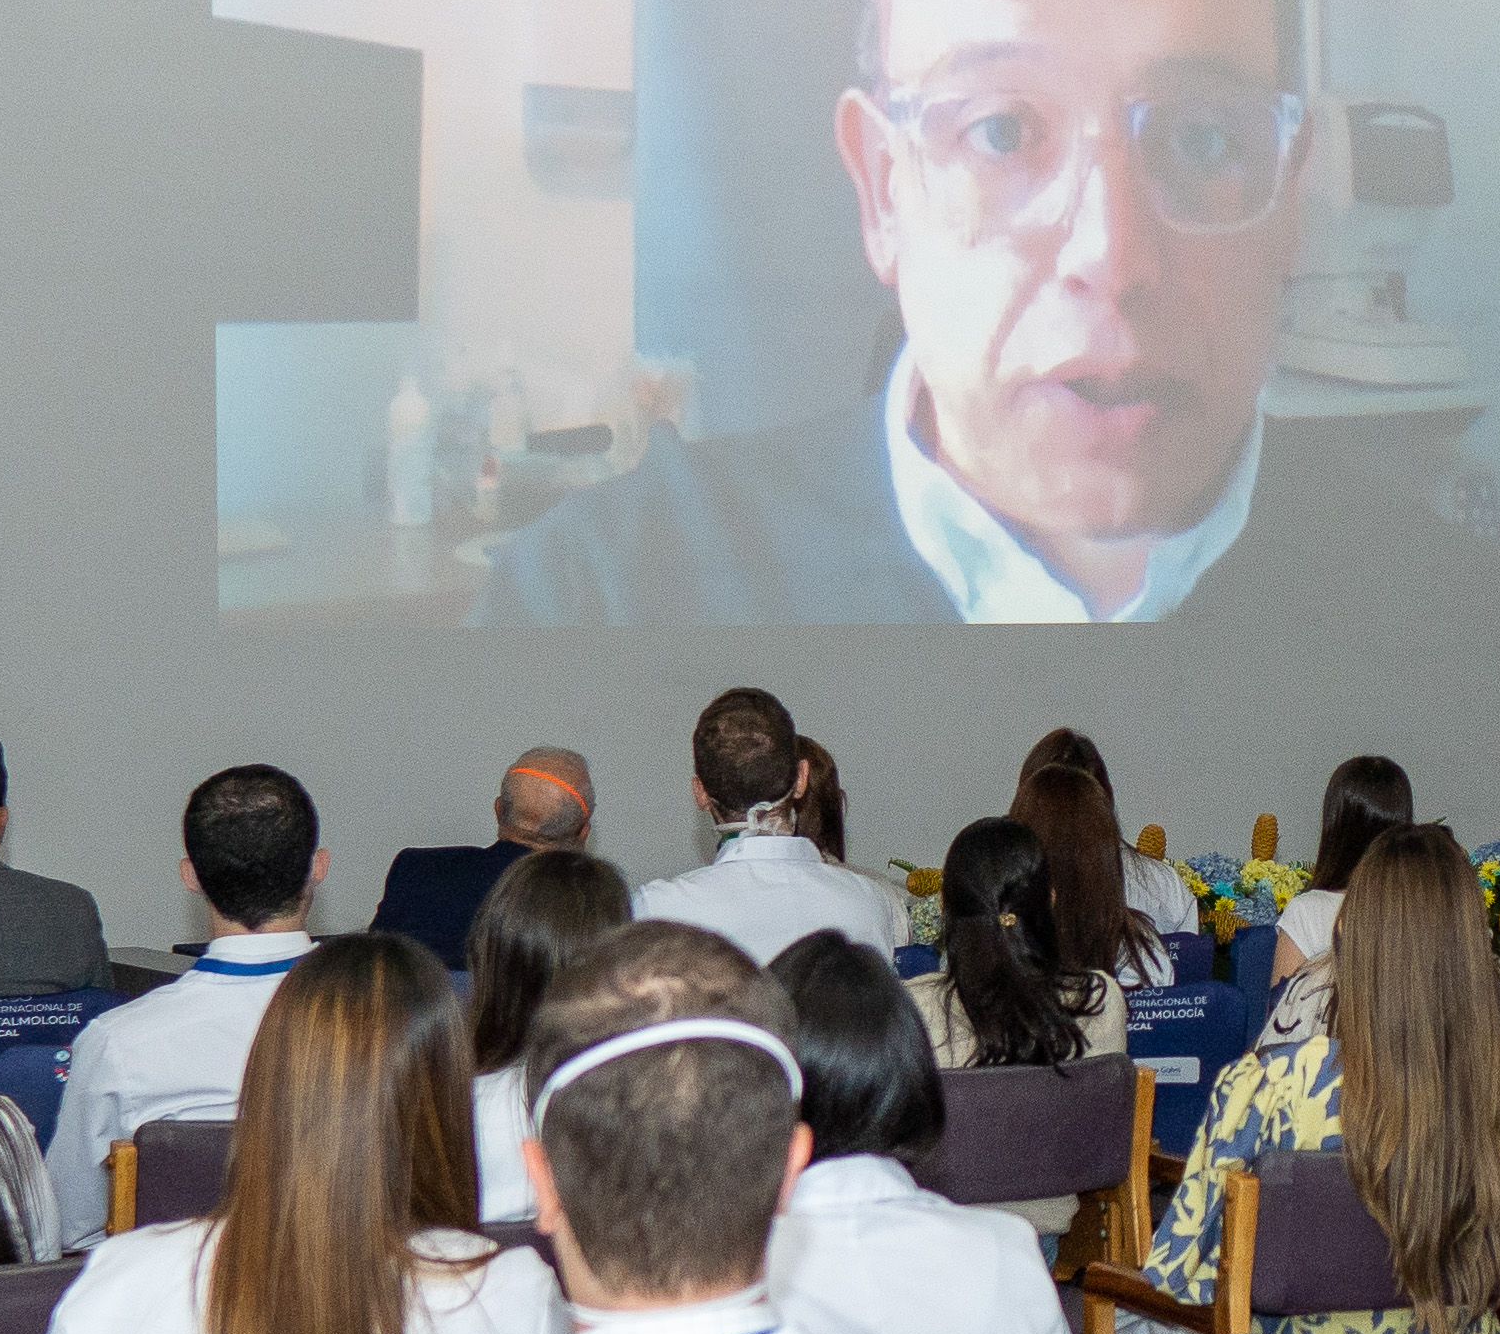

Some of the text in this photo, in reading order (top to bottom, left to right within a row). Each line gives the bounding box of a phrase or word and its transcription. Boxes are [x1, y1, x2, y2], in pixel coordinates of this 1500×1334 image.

[67, 1002, 83, 1012] DE
[1129, 995, 1208, 1008] ERNACIONAL DE
[1130, 1007, 1205, 1021] TALMOLOGÍA
[1126, 1022, 1153, 1032] SCAL
